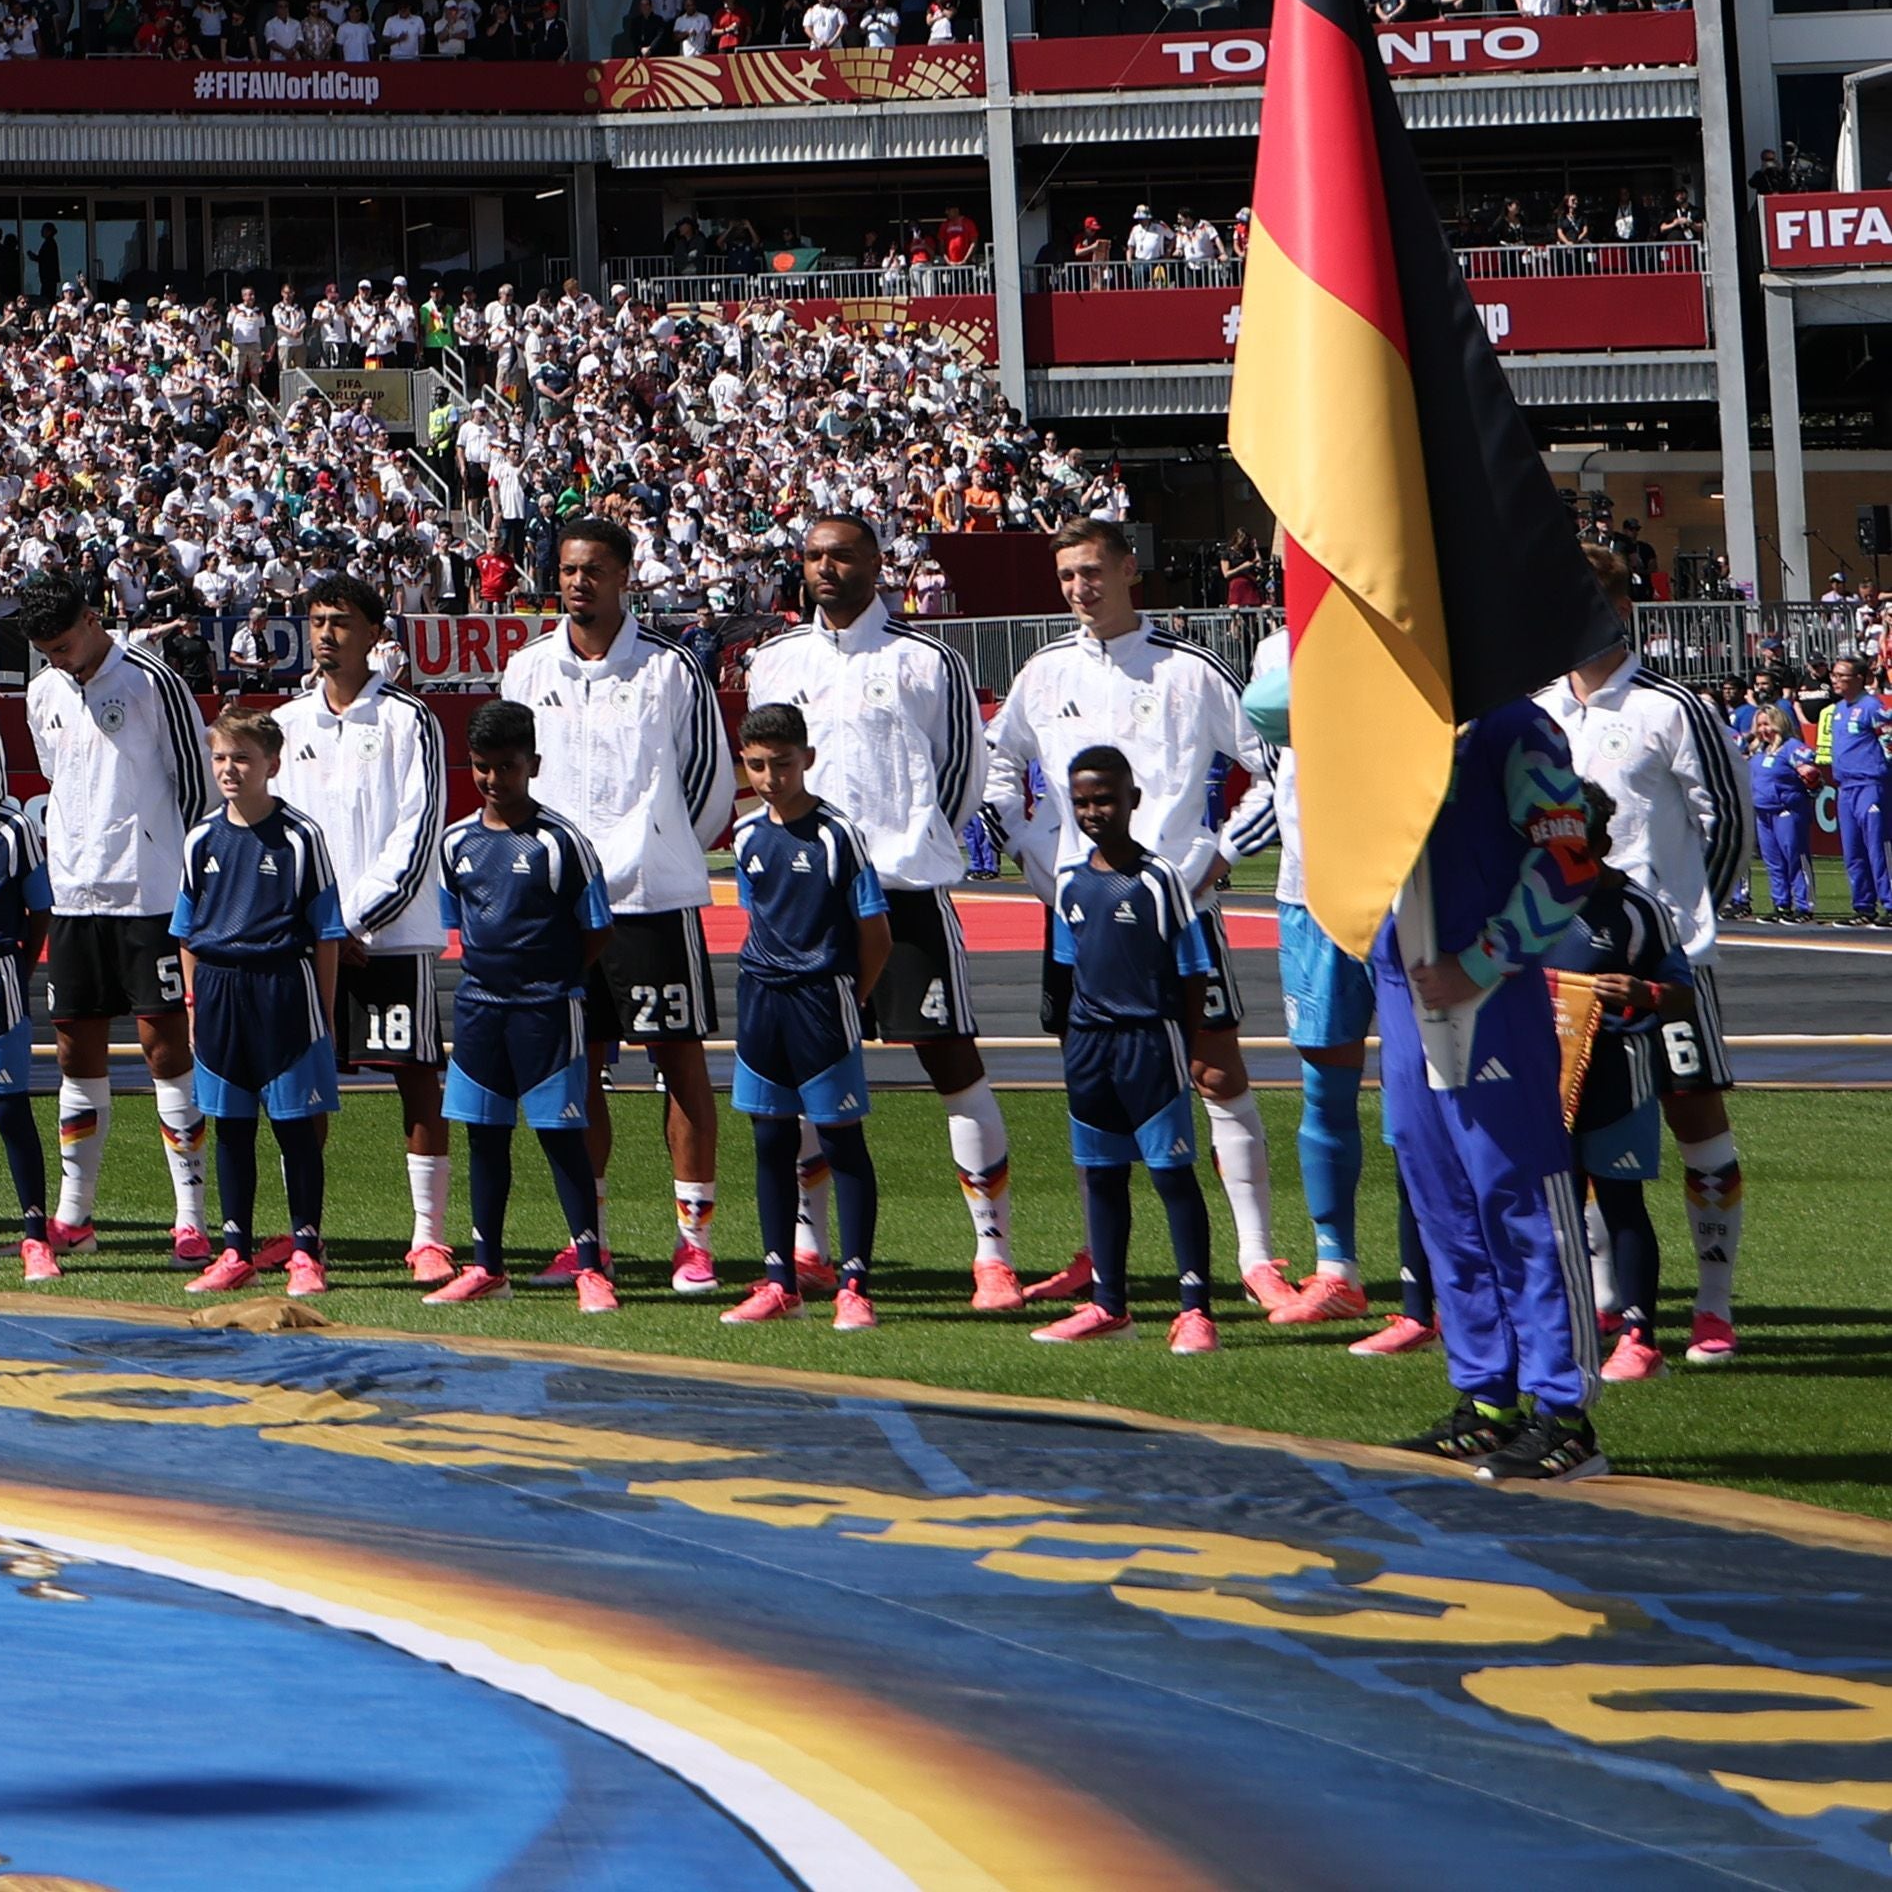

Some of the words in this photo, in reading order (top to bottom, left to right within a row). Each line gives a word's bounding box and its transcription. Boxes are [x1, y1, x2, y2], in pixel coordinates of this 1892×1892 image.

[1160, 26, 1541, 75] TONTO
[193, 70, 381, 105] #FIFAWorldCup
[1775, 206, 1892, 250] FIFA
[336, 379, 362, 389] FIFA
[157, 956, 182, 1001] 5
[920, 977, 949, 1026] 4
[366, 1003, 412, 1050] 18
[630, 982, 689, 1032] 23
[1661, 1022, 1699, 1075] 6
[1697, 1222, 1727, 1237] DFB
